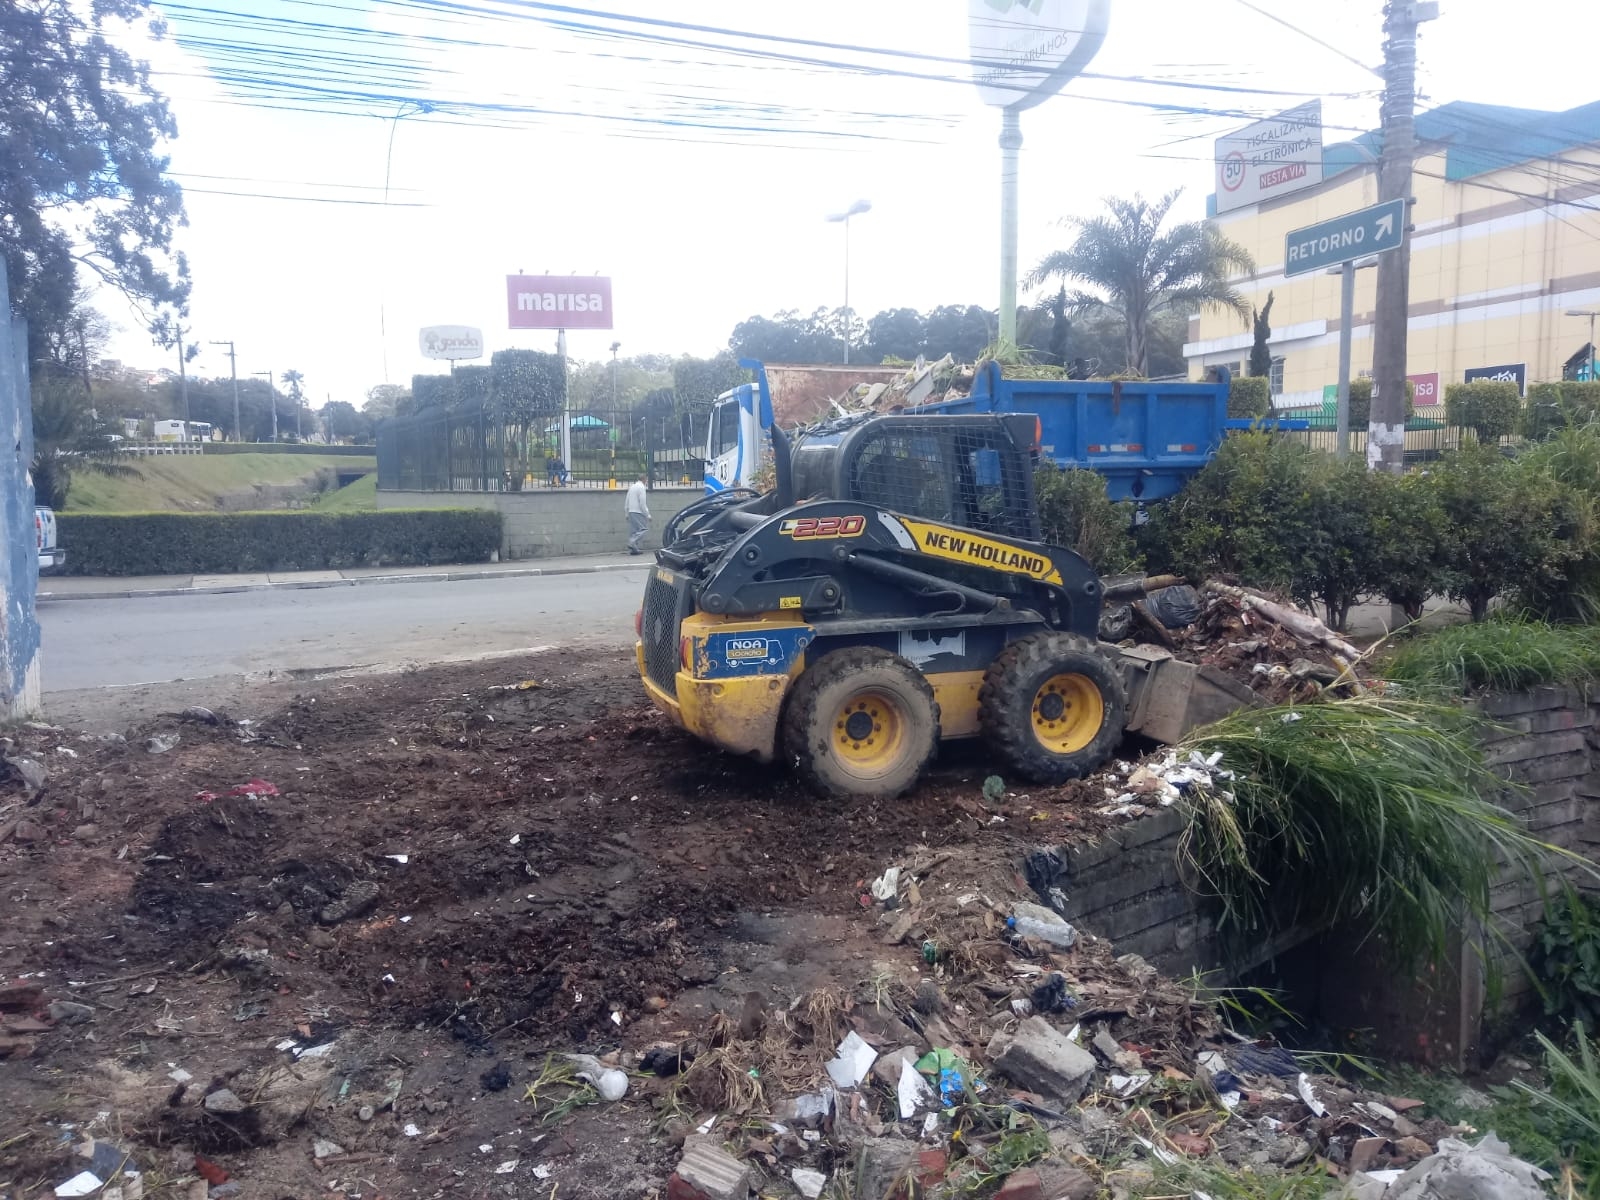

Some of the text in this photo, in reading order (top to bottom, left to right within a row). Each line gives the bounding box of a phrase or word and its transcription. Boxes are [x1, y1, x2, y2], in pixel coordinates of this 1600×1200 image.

[1252, 137, 1312, 167] ELETRÔNICA
[1226, 160, 1240, 178] 50
[1260, 163, 1305, 189] NESTA VIA
[1289, 226, 1365, 262] RETORNO
[518, 292, 603, 312] marisa
[1413, 382, 1434, 396] isa
[925, 531, 1044, 574] NEW HOLLAND
[732, 640, 762, 650] NOA
